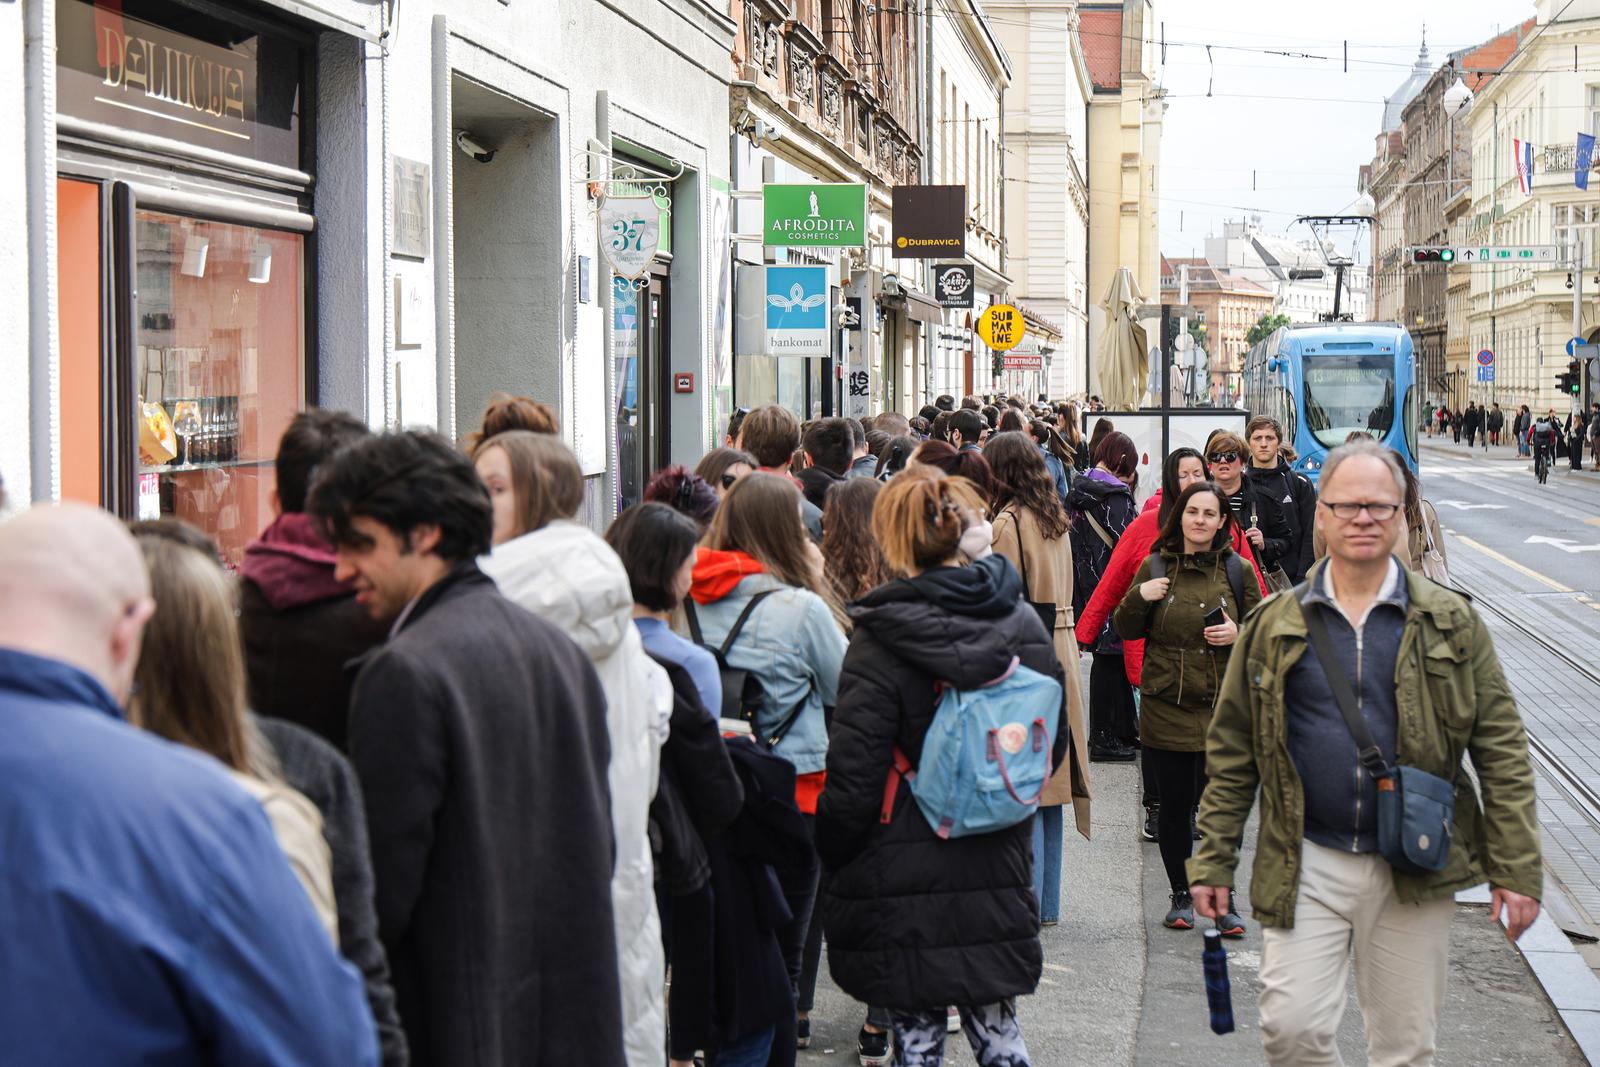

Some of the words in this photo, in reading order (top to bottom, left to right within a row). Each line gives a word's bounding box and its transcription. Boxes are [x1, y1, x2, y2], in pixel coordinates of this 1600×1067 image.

[772, 218, 856, 232] AFRODITA
[612, 219, 646, 252] 37
[788, 232, 840, 240] COSMETICS
[908, 238, 961, 247] DUBRAVICA
[991, 310, 1013, 321] SUB
[991, 321, 1012, 333] MAR
[770, 336, 823, 348] bankomat
